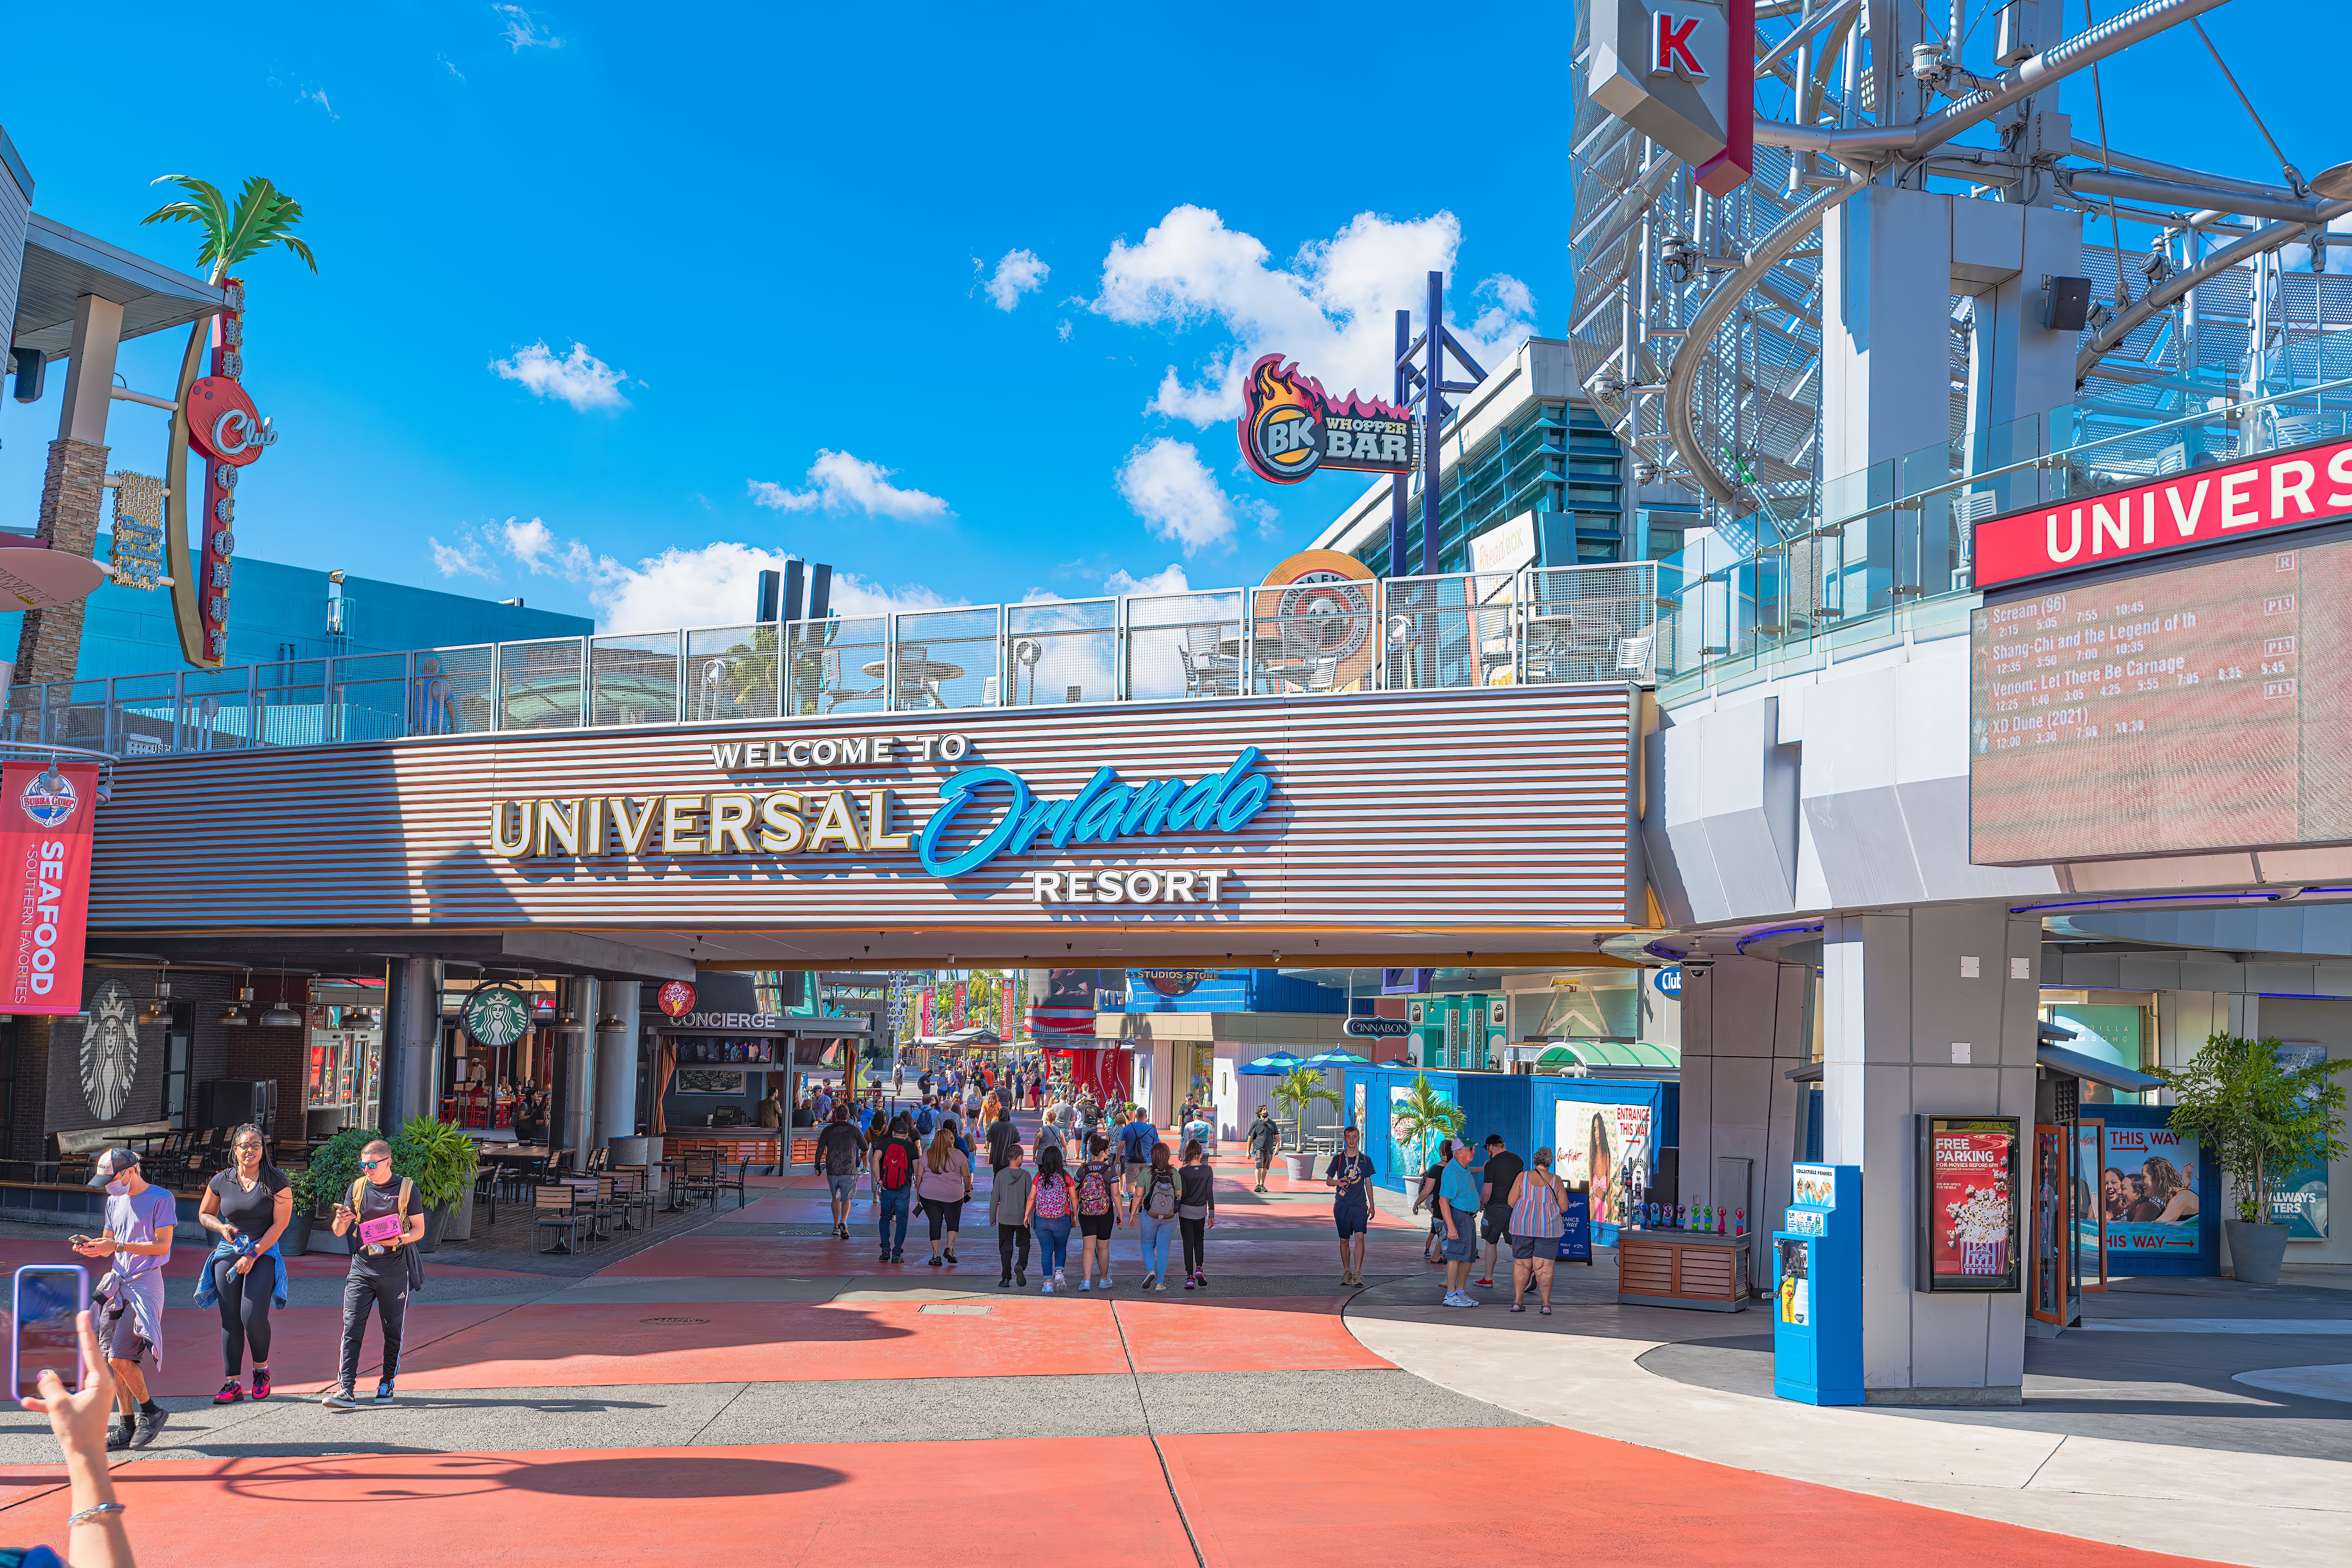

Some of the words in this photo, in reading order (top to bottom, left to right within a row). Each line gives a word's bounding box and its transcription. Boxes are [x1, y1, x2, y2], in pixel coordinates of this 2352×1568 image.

[1651, 10, 1711, 82] K
[213, 409, 278, 455] Club
[1268, 415, 1315, 456] BK
[1326, 417, 1407, 435] WHOPPER
[1326, 430, 1407, 462] BAR
[2046, 448, 2352, 563] UNIVERS
[1993, 603, 2038, 624] Scream
[2041, 595, 2067, 617] (96)
[2117, 601, 2144, 616] 10:45
[1993, 636, 2054, 661] Shang-Chi
[2058, 630, 2081, 649] and
[2084, 628, 2106, 644] the
[2109, 617, 2160, 641] Legend
[2164, 614, 2179, 631] of
[2076, 647, 2098, 661] 7:00
[2117, 639, 2144, 655] 10:35
[1993, 679, 2037, 697] Venom:
[2041, 674, 2061, 691] Let
[2065, 669, 2101, 686] There
[2105, 664, 2122, 680] Be
[2127, 656, 2185, 677] Carnage
[1993, 718, 2009, 734] XD
[2012, 715, 2044, 732] Dune
[2047, 707, 2089, 730] (2021)
[711, 737, 898, 769] WELCOME
[922, 732, 972, 762] TO
[24, 796, 50, 806] BUBBA
[52, 796, 75, 807] GUMP
[490, 789, 915, 859] UNIVERSAL
[919, 745, 1273, 878] Orlando
[1033, 868, 1232, 903] RESORT
[31, 840, 64, 995] SEAFOOD
[15, 930, 33, 1004] FAVORITES
[1186, 971, 1220, 980] STORE
[669, 1012, 776, 1028] CONCIERGE
[1617, 1107, 1650, 1122] ENTRANCE
[1620, 1122, 1633, 1136] THIS
[1635, 1123, 1649, 1137] WAY
[2110, 1131, 2144, 1145] THIS
[2149, 1132, 2181, 1145] WAY
[1935, 1138, 1970, 1150] FREE
[1936, 1150, 1994, 1162] PARKING
[2268, 1192, 2316, 1203] ALWAYS
[2273, 1203, 2302, 1213] TERS
[2106, 1235, 2127, 1248] HIS
[2133, 1235, 2166, 1249] WAY
